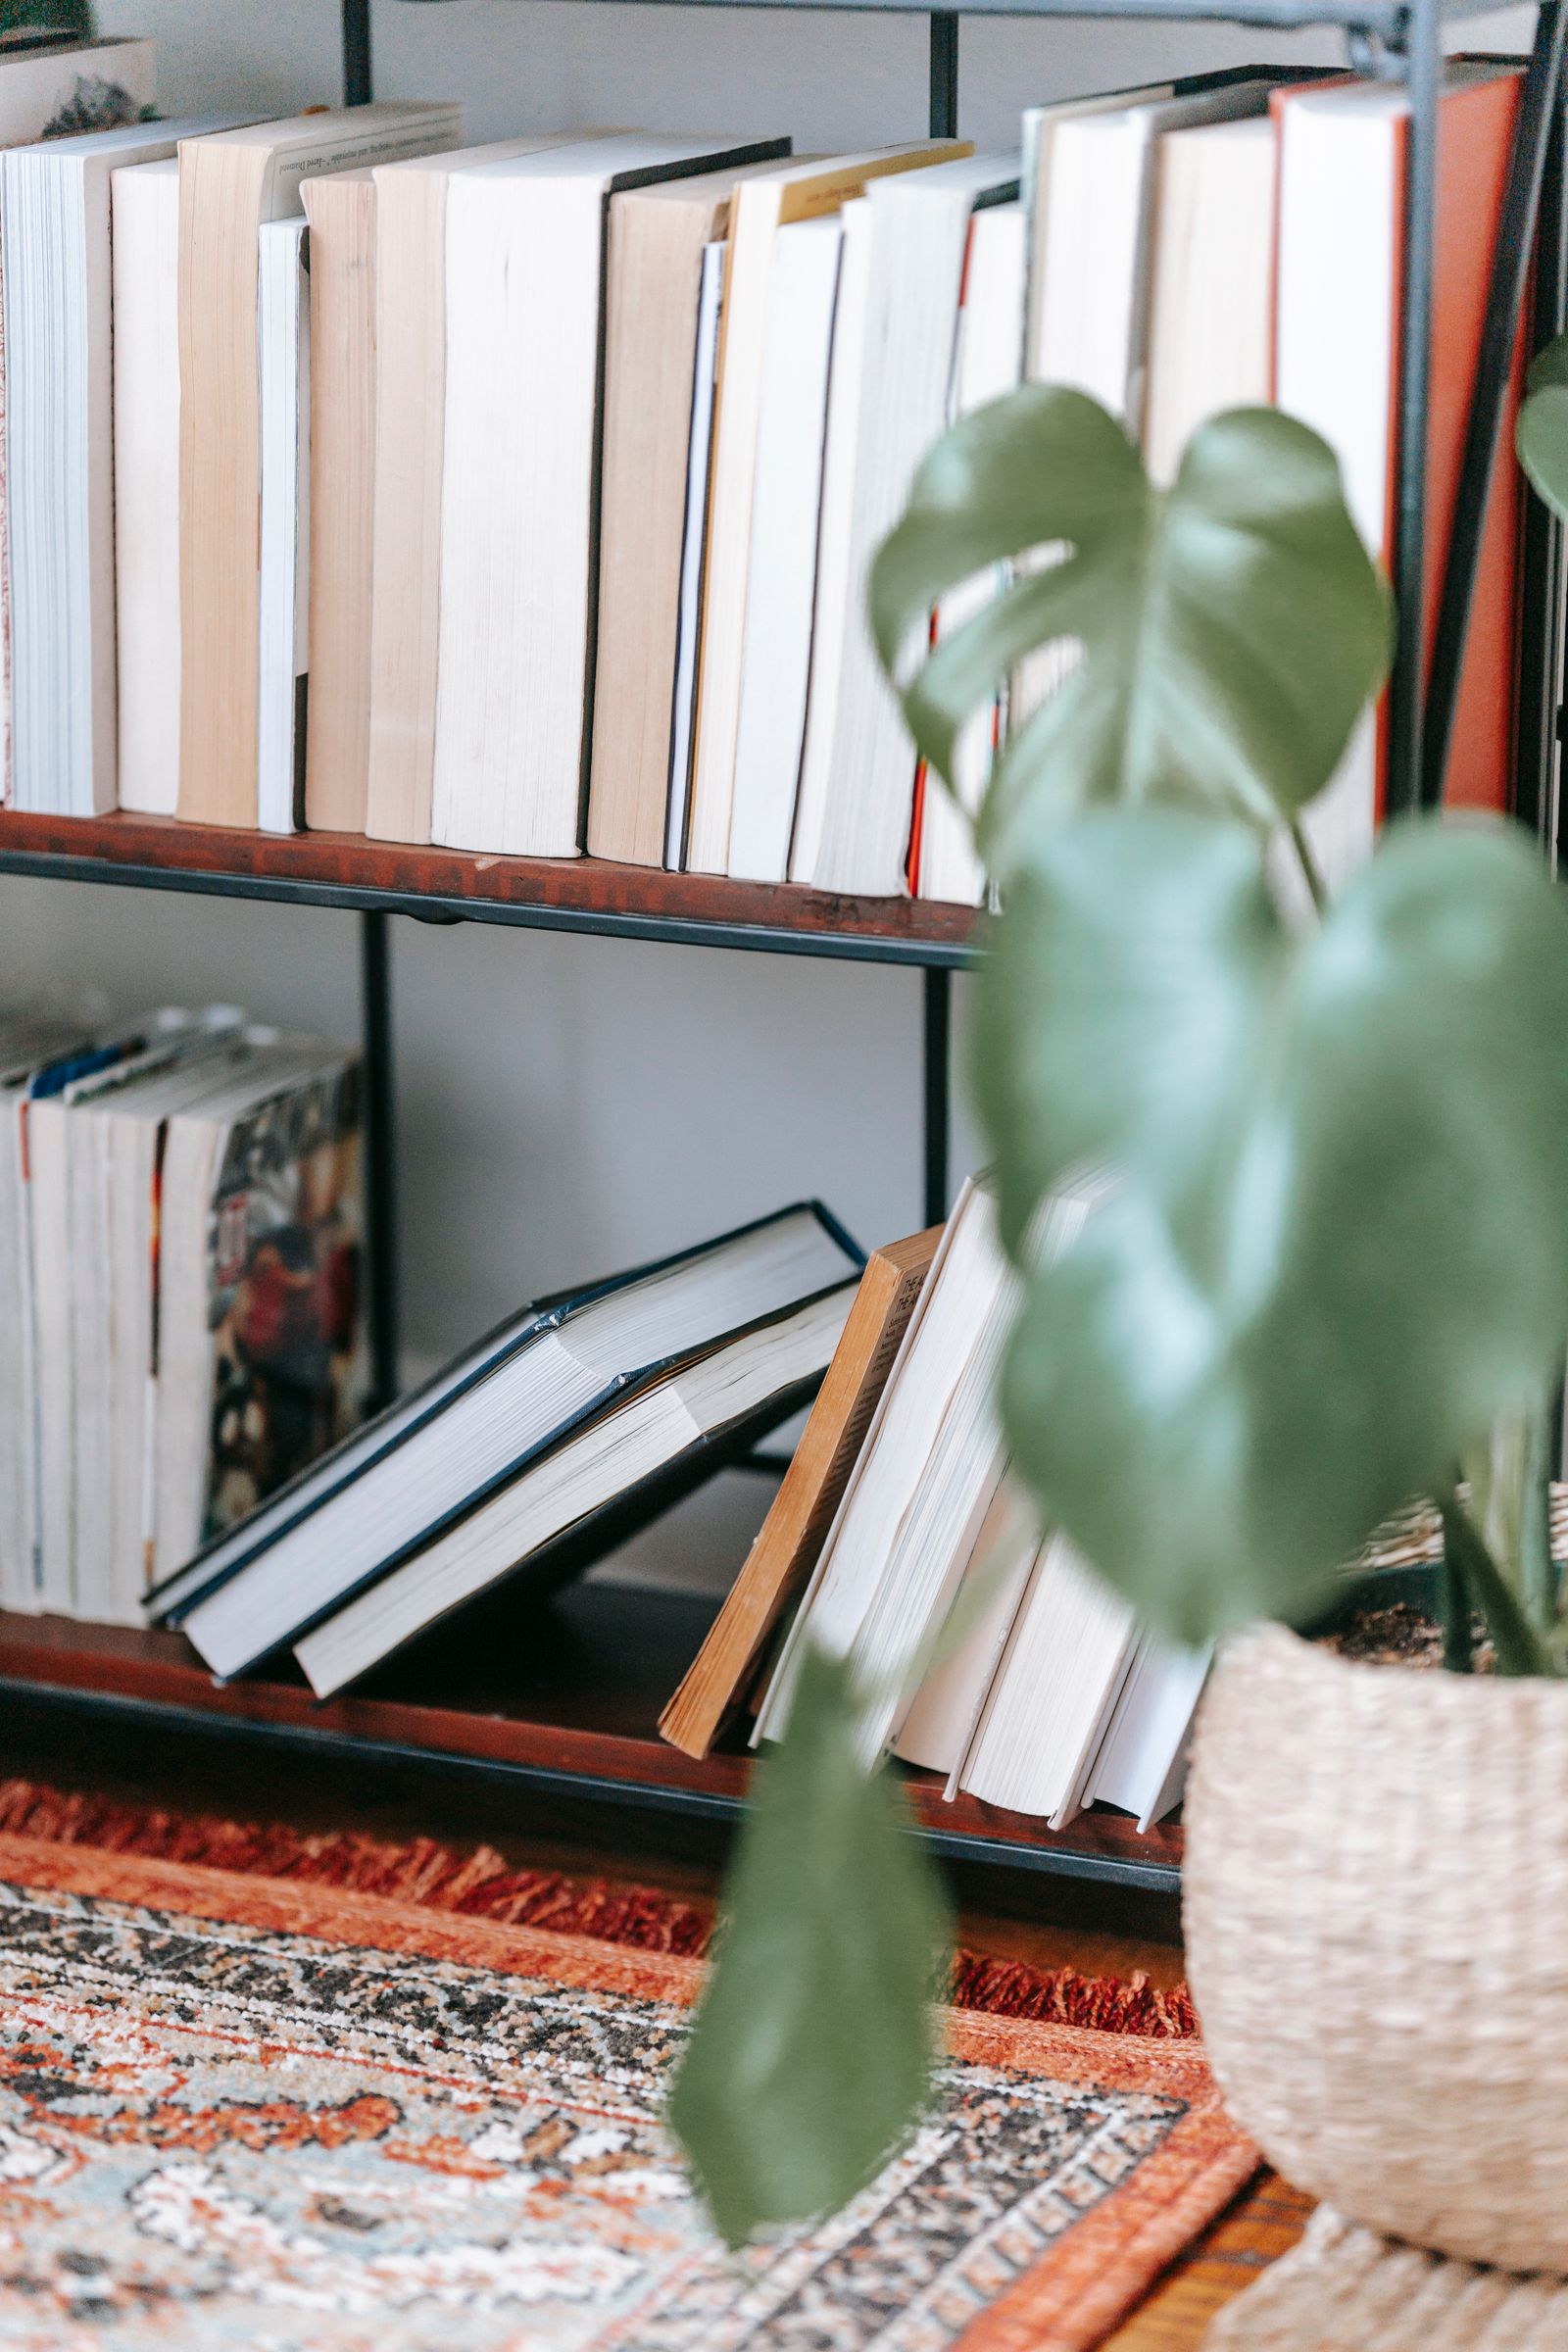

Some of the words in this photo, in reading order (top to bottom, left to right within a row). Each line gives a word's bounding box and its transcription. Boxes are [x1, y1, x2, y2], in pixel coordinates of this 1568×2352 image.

[279, 161, 306, 175] Diamond
[903, 1276, 917, 1294] THE
[896, 1294, 911, 1313] THE
